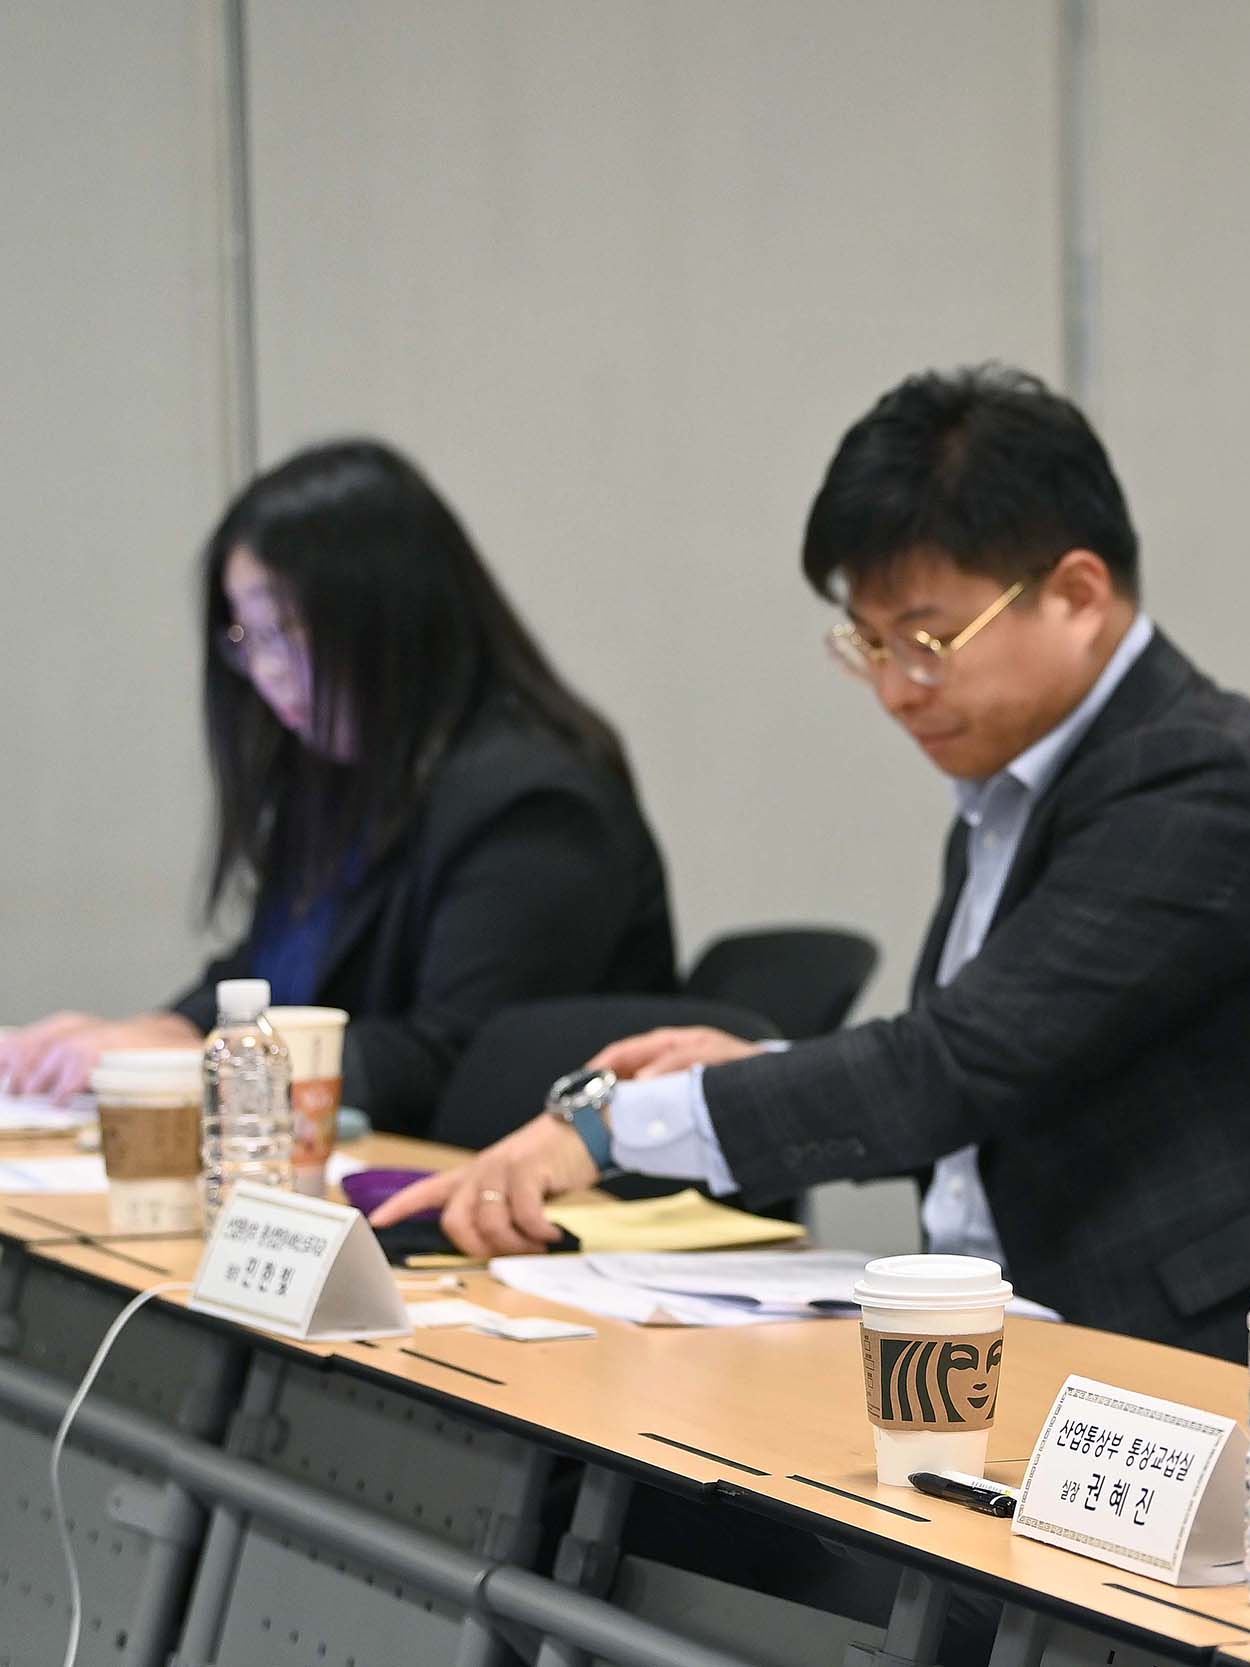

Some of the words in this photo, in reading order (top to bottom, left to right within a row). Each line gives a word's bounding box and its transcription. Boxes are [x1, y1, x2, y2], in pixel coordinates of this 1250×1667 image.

[1056, 1418, 1124, 1460] 산업통상부
[1125, 1438, 1196, 1482] 통상교섭실
[1060, 1479, 1080, 1503] 실장
